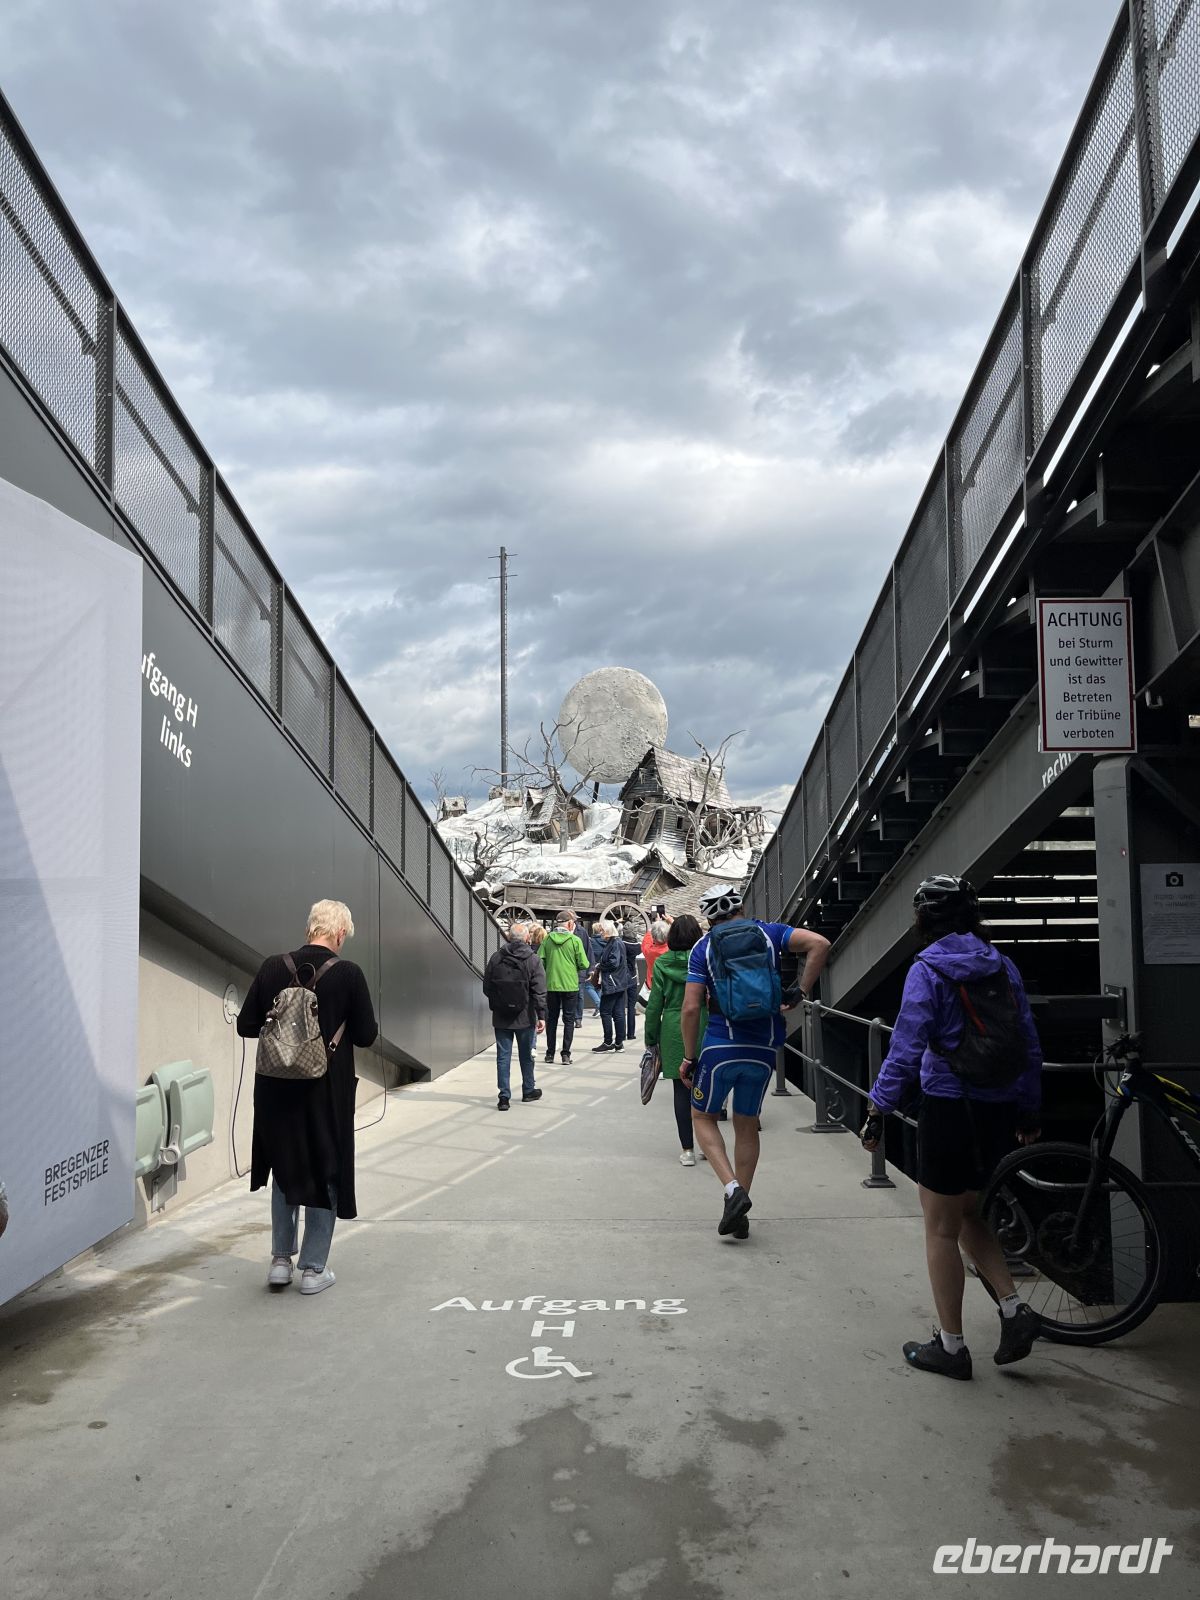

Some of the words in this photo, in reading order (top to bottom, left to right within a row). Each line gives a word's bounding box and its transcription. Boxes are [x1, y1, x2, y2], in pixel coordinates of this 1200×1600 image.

[1047, 611, 1123, 627] ACHTUNG
[1058, 637, 1076, 649] bei
[1079, 637, 1113, 649] Sturm
[1049, 655, 1071, 667] und
[1074, 655, 1124, 667] Gewitter
[1067, 673, 1083, 685] ist
[1086, 673, 1106, 685] das
[1063, 691, 1113, 703] Betreten
[187, 698, 198, 728] H
[1055, 709, 1075, 721] der
[1077, 708, 1121, 721] Tribüne
[1062, 727, 1115, 739] verboten
[160, 715, 193, 768] links
[44, 1139, 110, 1186] BREGENZER
[44, 1157, 109, 1206] FESTSPIELE
[429, 1295, 688, 1316] Aufgang
[530, 1320, 576, 1338] H
